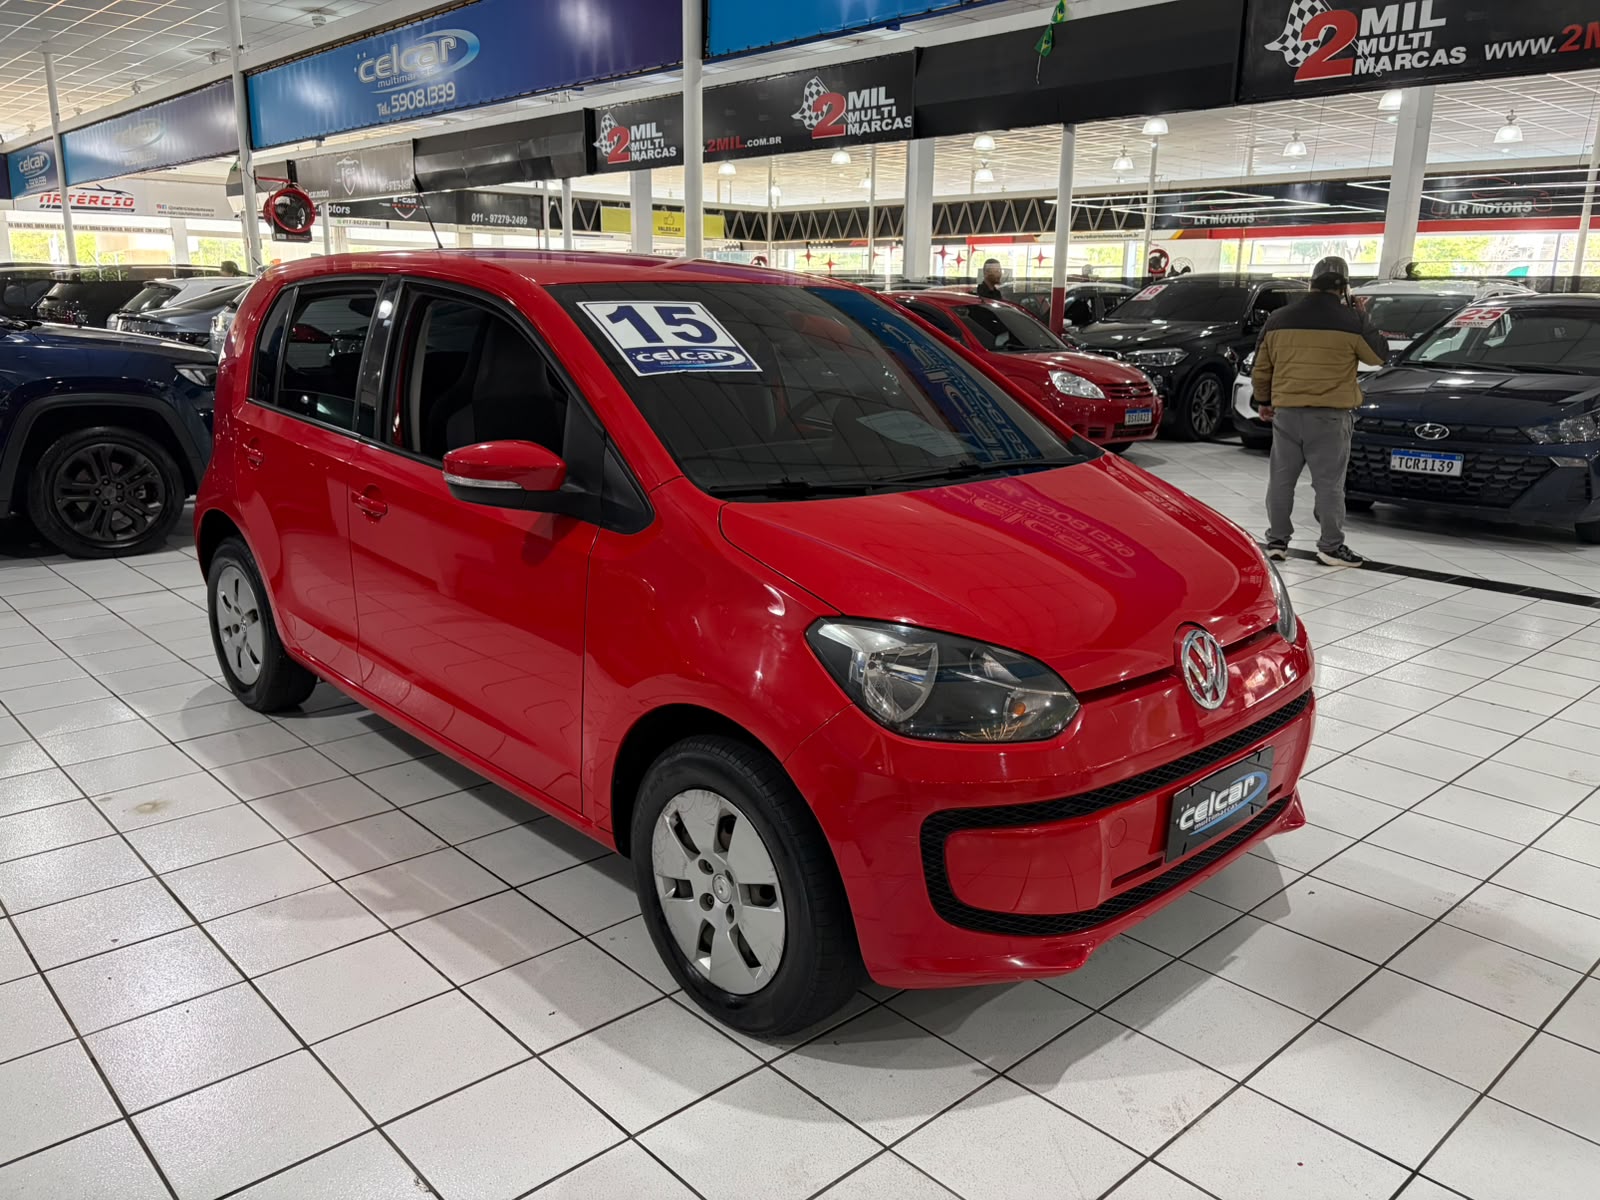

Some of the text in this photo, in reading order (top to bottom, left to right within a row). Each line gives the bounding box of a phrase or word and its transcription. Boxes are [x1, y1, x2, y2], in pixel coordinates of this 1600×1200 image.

[1294, 0, 1447, 82] 2 MIL
[1356, 30, 1433, 55] MULTI
[358, 35, 457, 83] celcar
[1354, 46, 1467, 75] MARCAS
[391, 82, 456, 113] 5908.1339
[811, 86, 895, 139] 2 MIL
[847, 105, 897, 123] MULTI
[847, 115, 913, 136] MARCAS
[607, 122, 663, 164] 2 MIL
[631, 138, 665, 150] MULTI
[631, 147, 677, 162] MARCAS
[18, 154, 46, 173] celcar
[1209, 213, 1256, 224] MOTORS
[1450, 201, 1532, 215] LR MOTORS
[606, 305, 718, 344] 15
[1457, 308, 1505, 320] 25
[636, 349, 729, 364] celcar
[1398, 457, 1454, 473] TCR1I39
[1179, 775, 1255, 831] celcar
[1193, 802, 1239, 831] multimarcas
